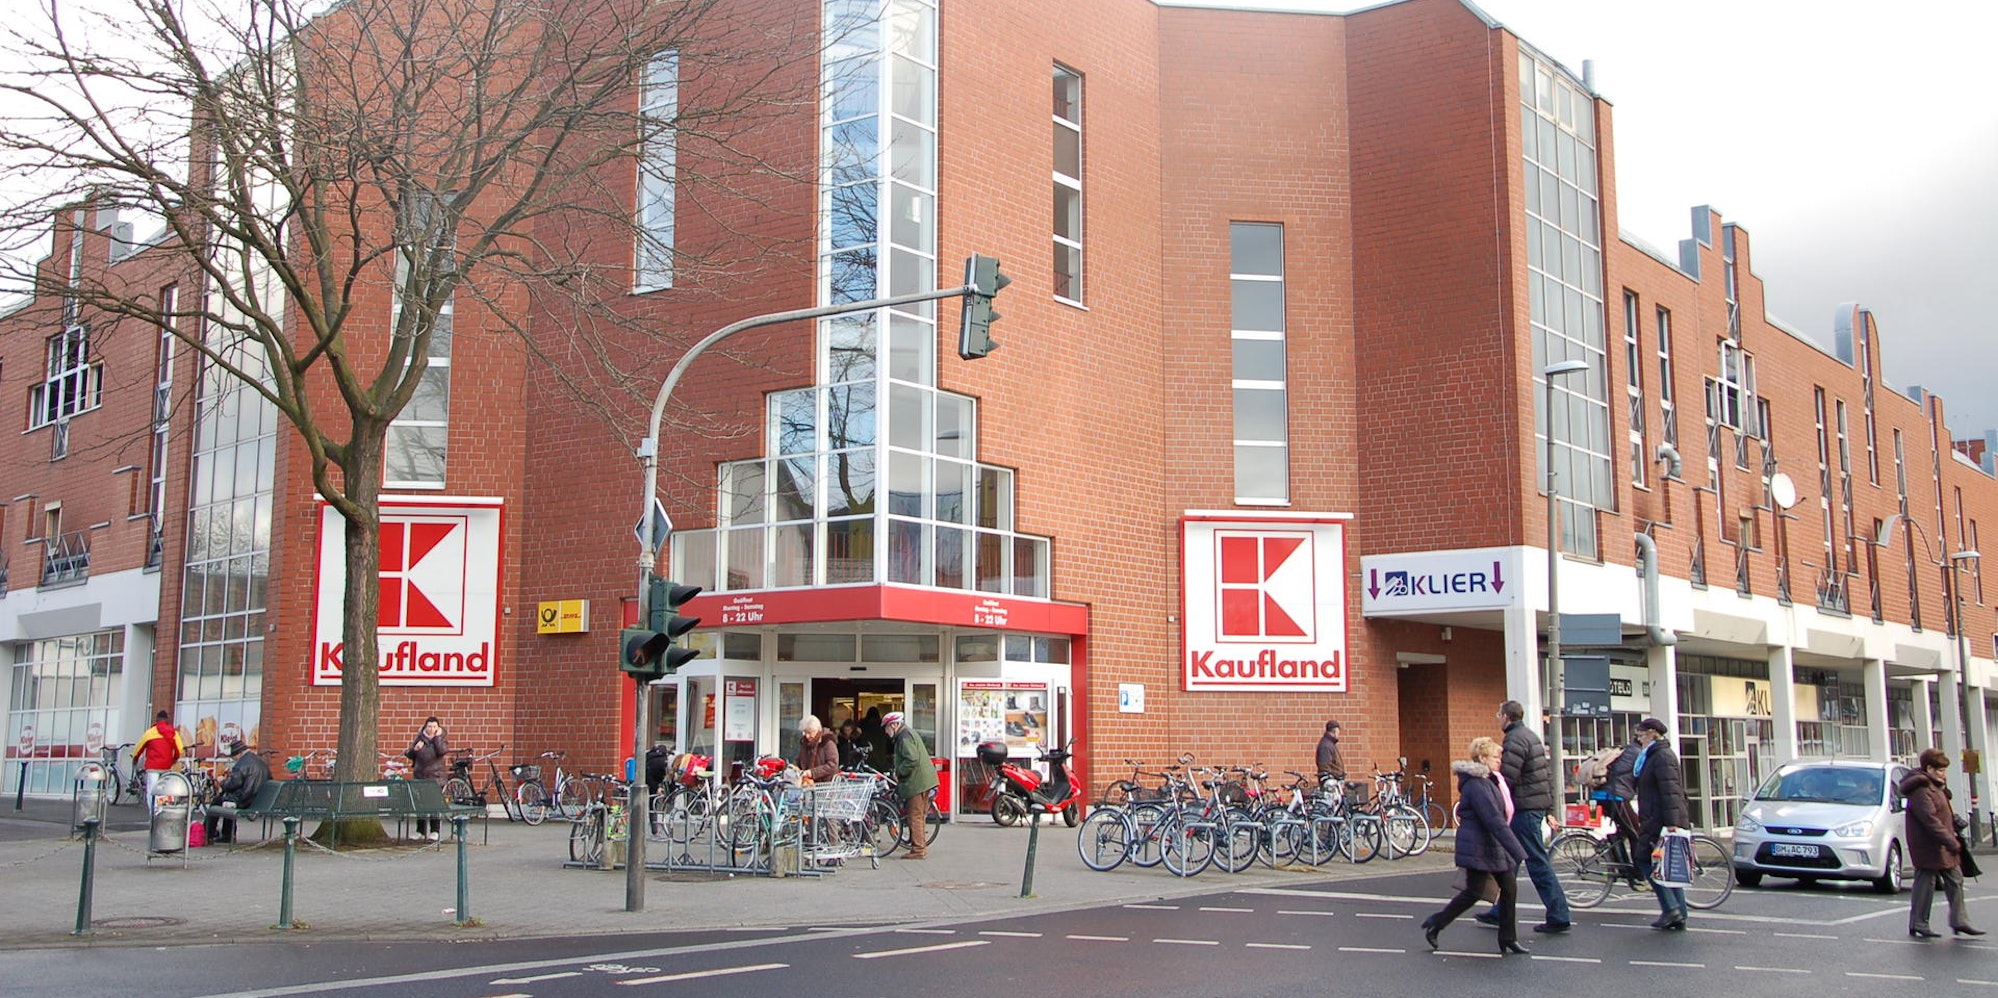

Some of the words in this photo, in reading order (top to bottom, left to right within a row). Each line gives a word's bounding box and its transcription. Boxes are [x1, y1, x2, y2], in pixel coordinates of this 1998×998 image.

[1411, 572, 1487, 595] KLIER
[722, 613, 728, 623] 8
[735, 612, 746, 622] 22
[747, 611, 764, 622] Uhr
[320, 641, 489, 673] Kufland
[1191, 649, 1341, 679] Kaufland
[1776, 845, 1787, 853] BM
[1791, 846, 1802, 854] AC
[1802, 846, 1818, 855] 793
